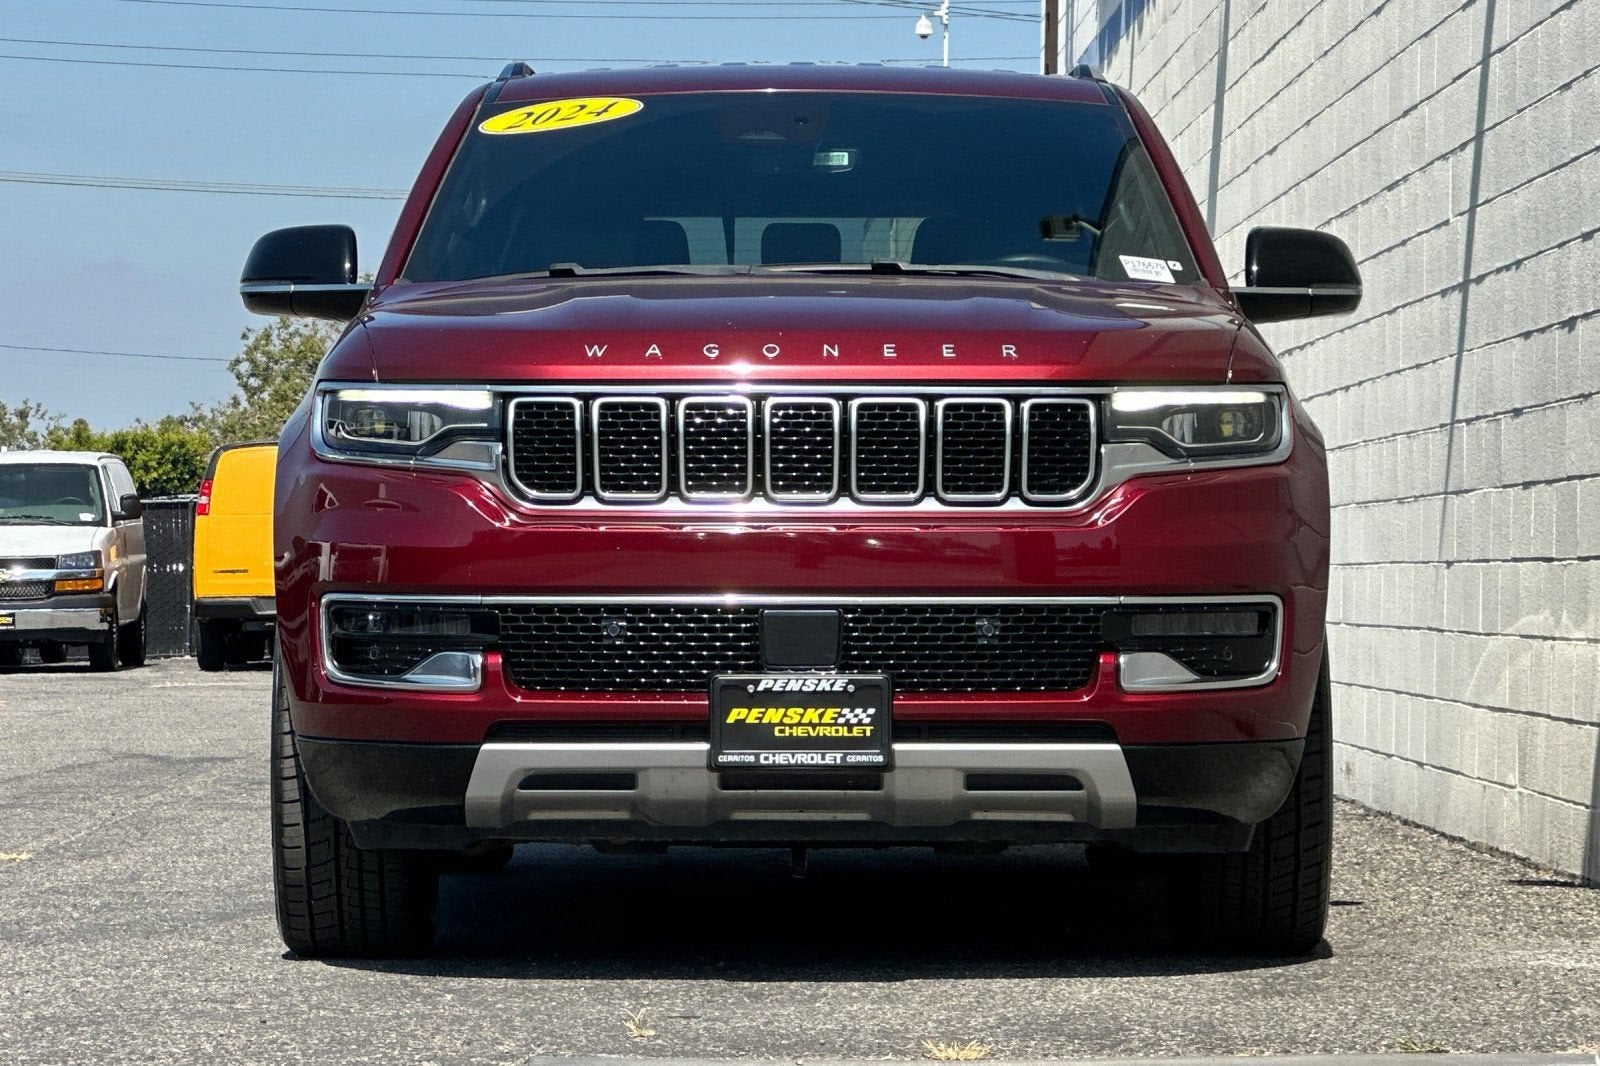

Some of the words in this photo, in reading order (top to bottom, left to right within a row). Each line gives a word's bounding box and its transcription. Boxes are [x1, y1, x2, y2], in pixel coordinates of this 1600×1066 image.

[504, 101, 619, 130] 2024
[584, 344, 1019, 359] WAGONEER
[757, 679, 848, 691] PENSKE
[726, 708, 841, 724] PENSKE
[774, 726, 874, 737] CHEVROLET
[760, 753, 843, 764] CHEVROLET
